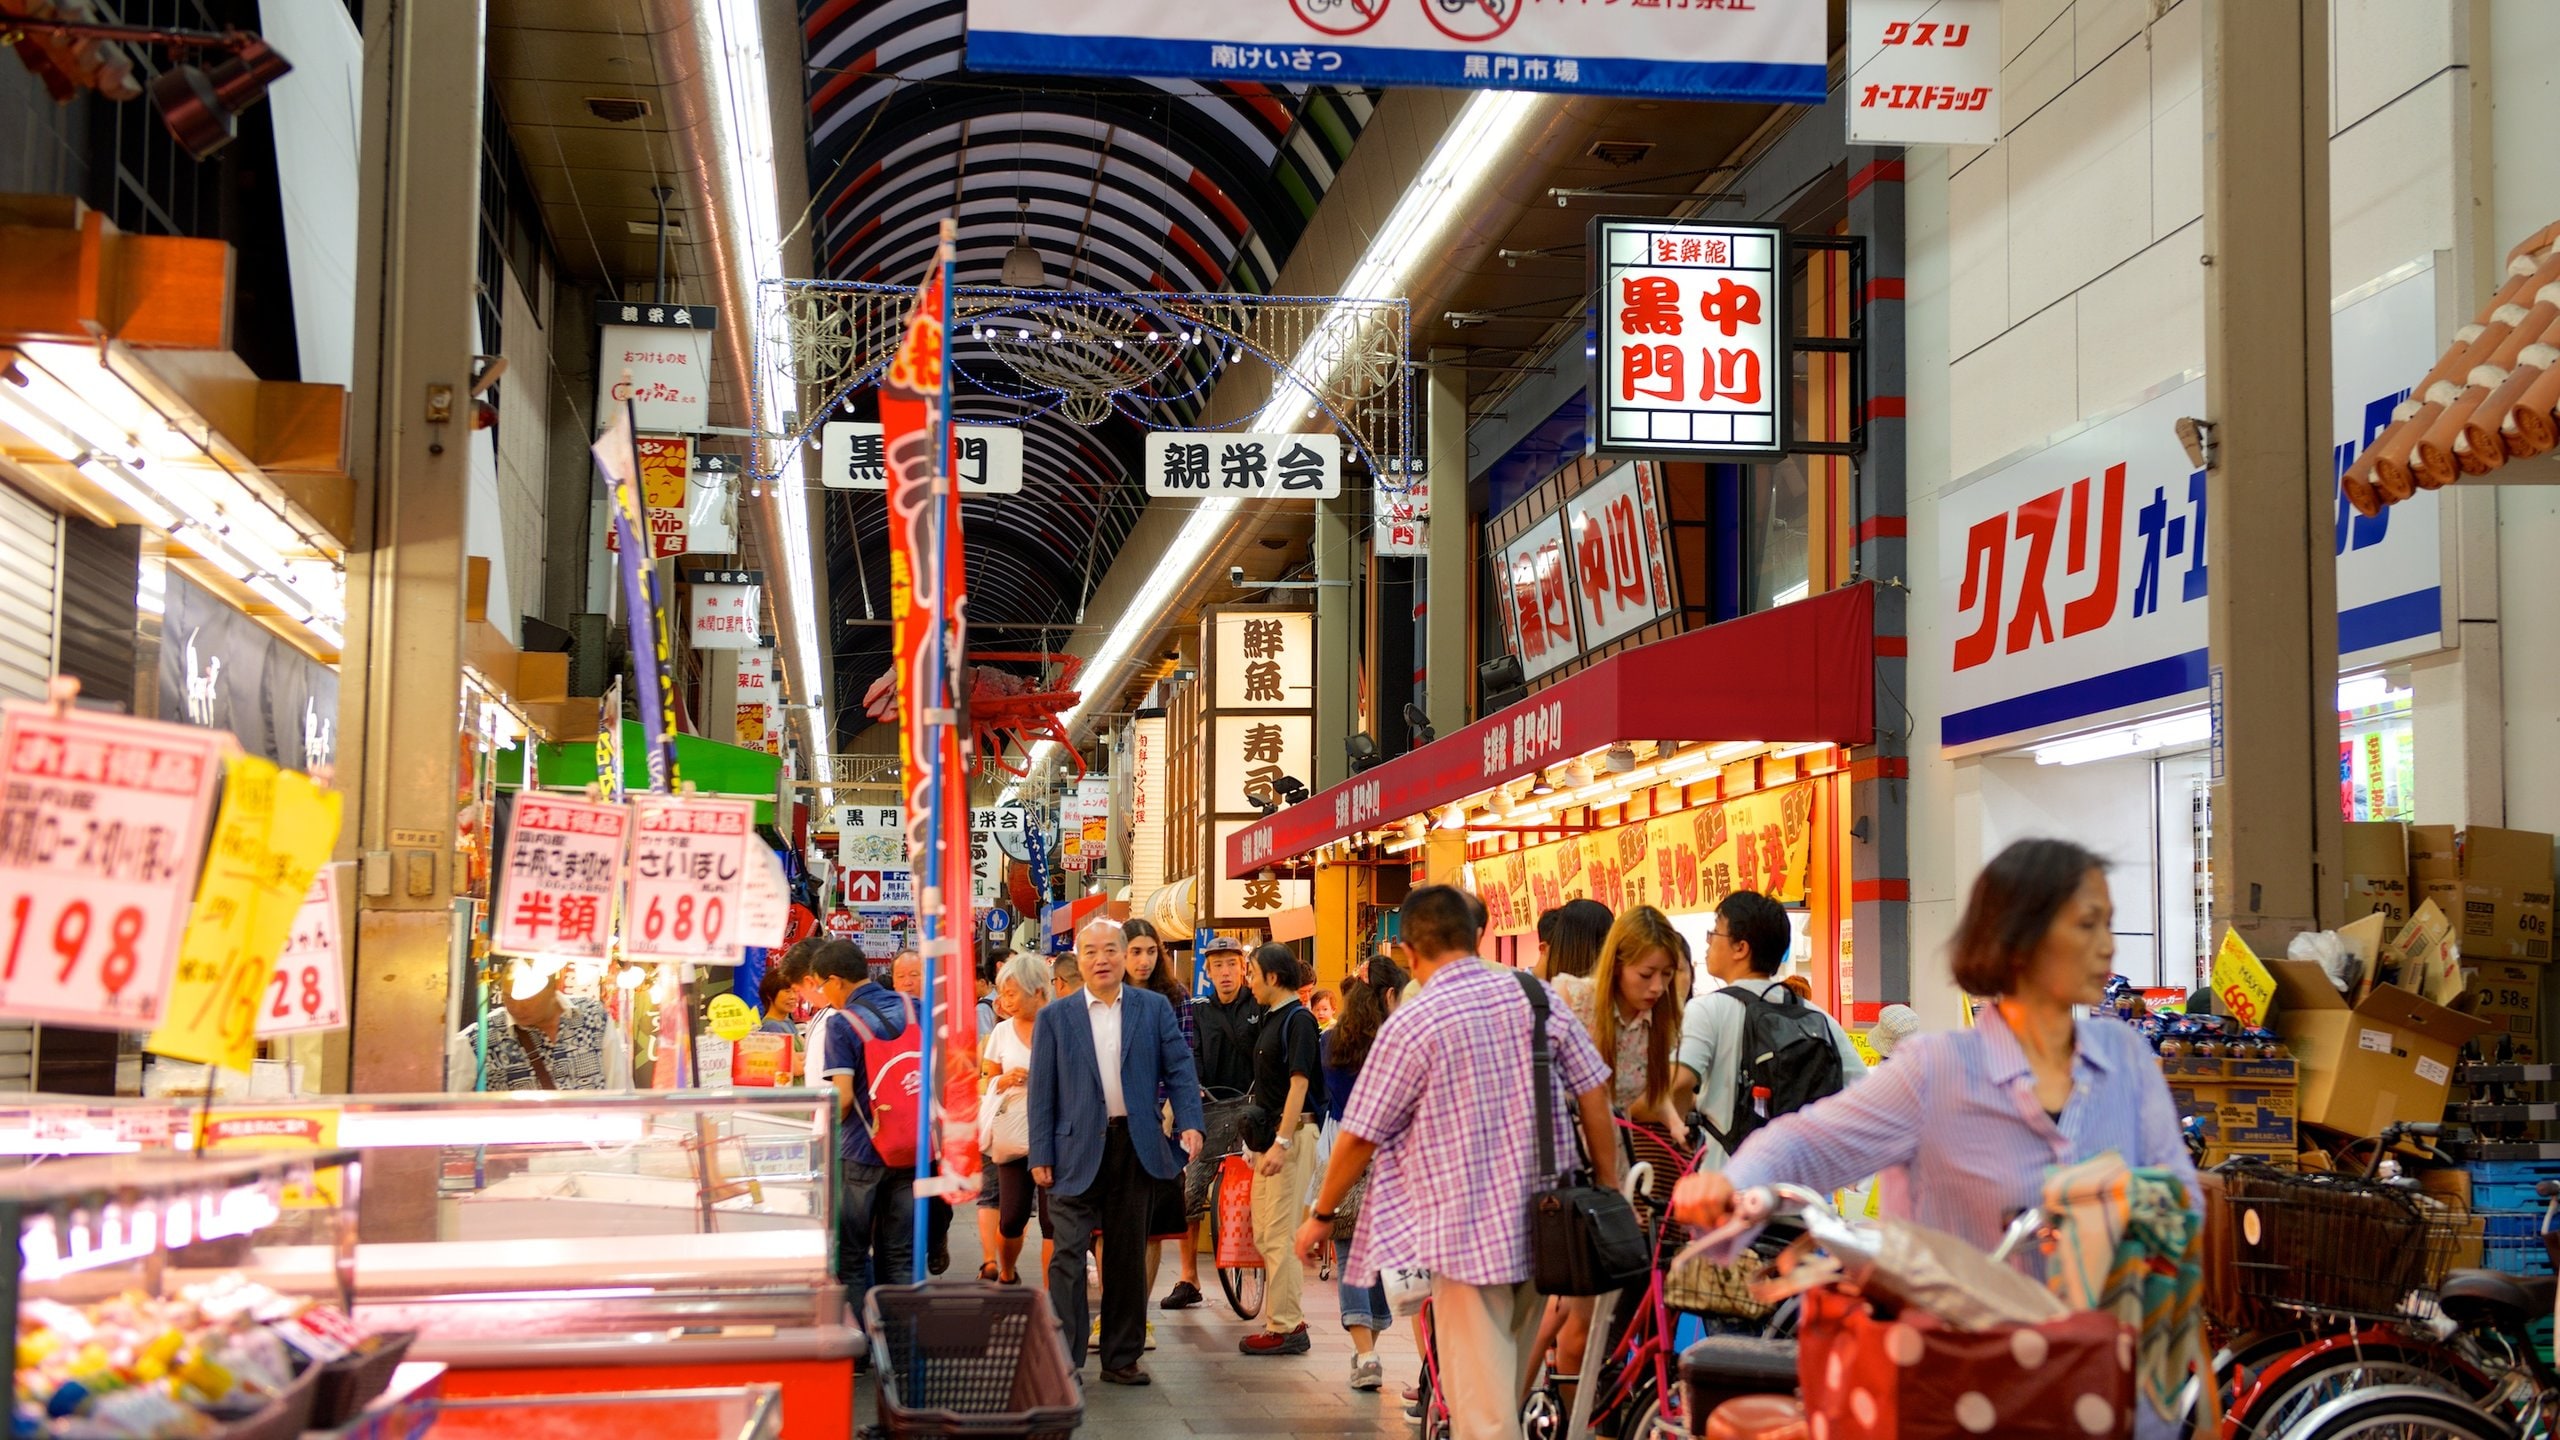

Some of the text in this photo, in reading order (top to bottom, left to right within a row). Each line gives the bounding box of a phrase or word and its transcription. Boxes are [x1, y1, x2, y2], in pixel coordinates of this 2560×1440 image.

[1882, 22, 1970, 47] クスリ
[1211, 46, 1579, 83] 南けいさつ 黒門市場
[1860, 84, 1993, 111] オーエスドラッグ
[1658, 239, 1726, 264] 生鮮館
[624, 351, 687, 364] おつけもの処
[1163, 442, 1325, 490] 親栄会
[1953, 461, 2127, 673] クスリ
[1243, 619, 1285, 702] 鮮魚
[1243, 723, 1284, 807] 寿司
[521, 805, 621, 836] お買得品
[846, 809, 898, 827] 黒門
[888, 883, 905, 891] 無料
[1656, 843, 1698, 910] 果物
[883, 892, 910, 901] 休憩所
[515, 890, 598, 943] 半額
[644, 894, 724, 943] 680
[2519, 914, 2546, 935] 60g
[4, 895, 146, 995] 198
[2500, 989, 2529, 1009] 58g
